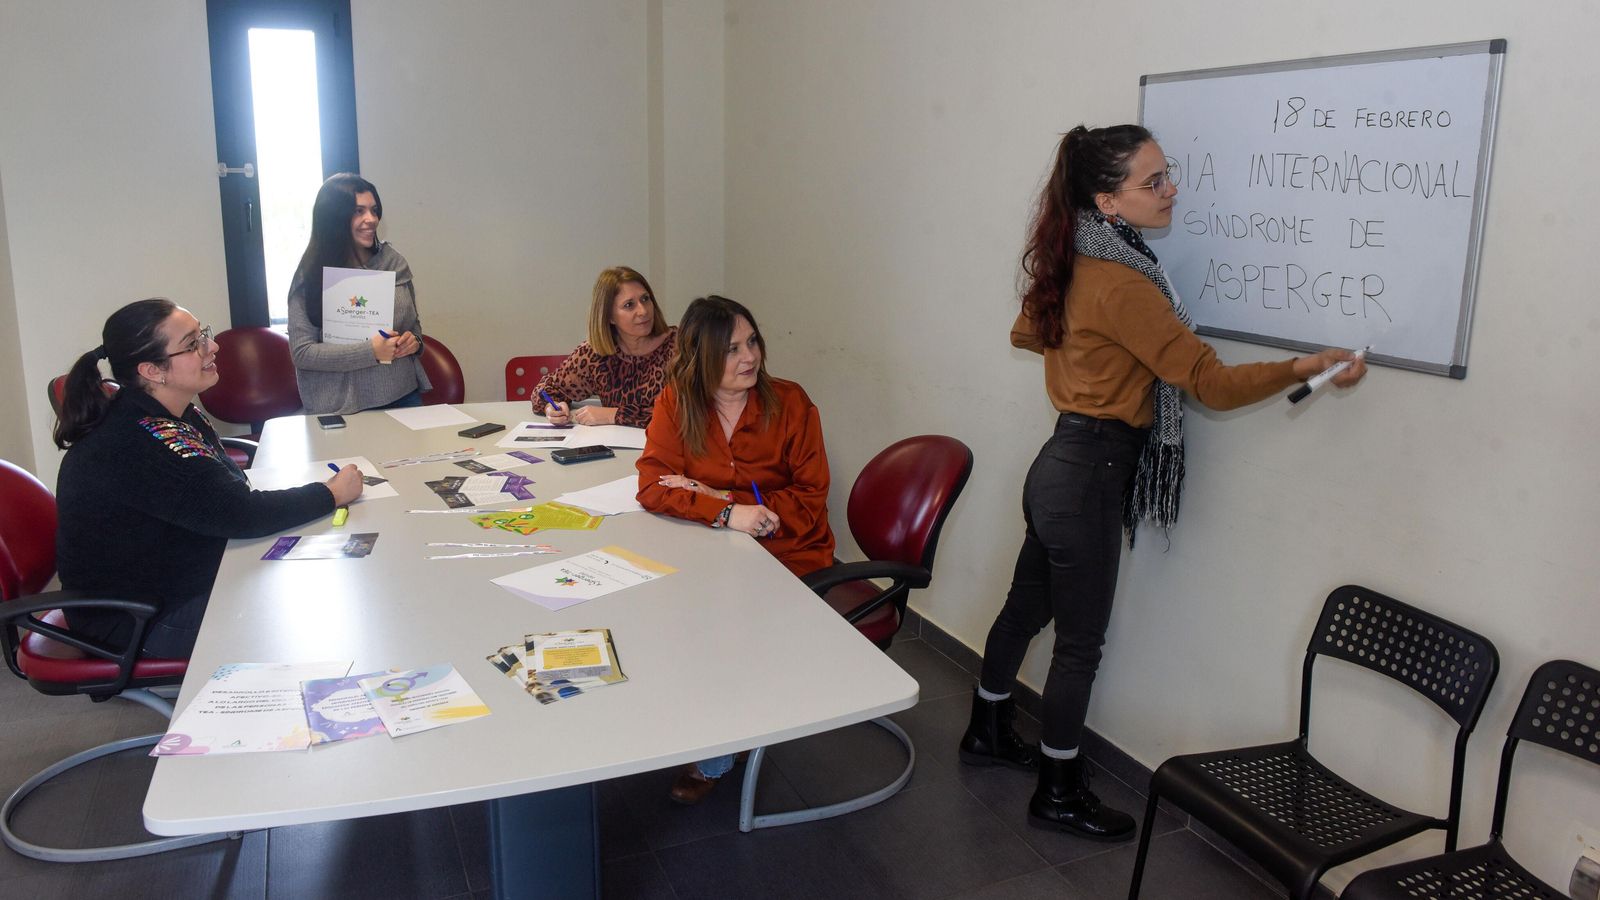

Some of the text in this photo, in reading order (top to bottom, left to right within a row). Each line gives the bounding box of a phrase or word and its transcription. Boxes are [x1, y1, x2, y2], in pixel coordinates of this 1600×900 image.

[1273, 96, 1452, 133] 18 DE FEBRERO
[1248, 149, 1472, 199] INTERNACIONAL
[1183, 202, 1385, 249] SÍNDROME DE
[1198, 258, 1393, 323] ASPERGER
